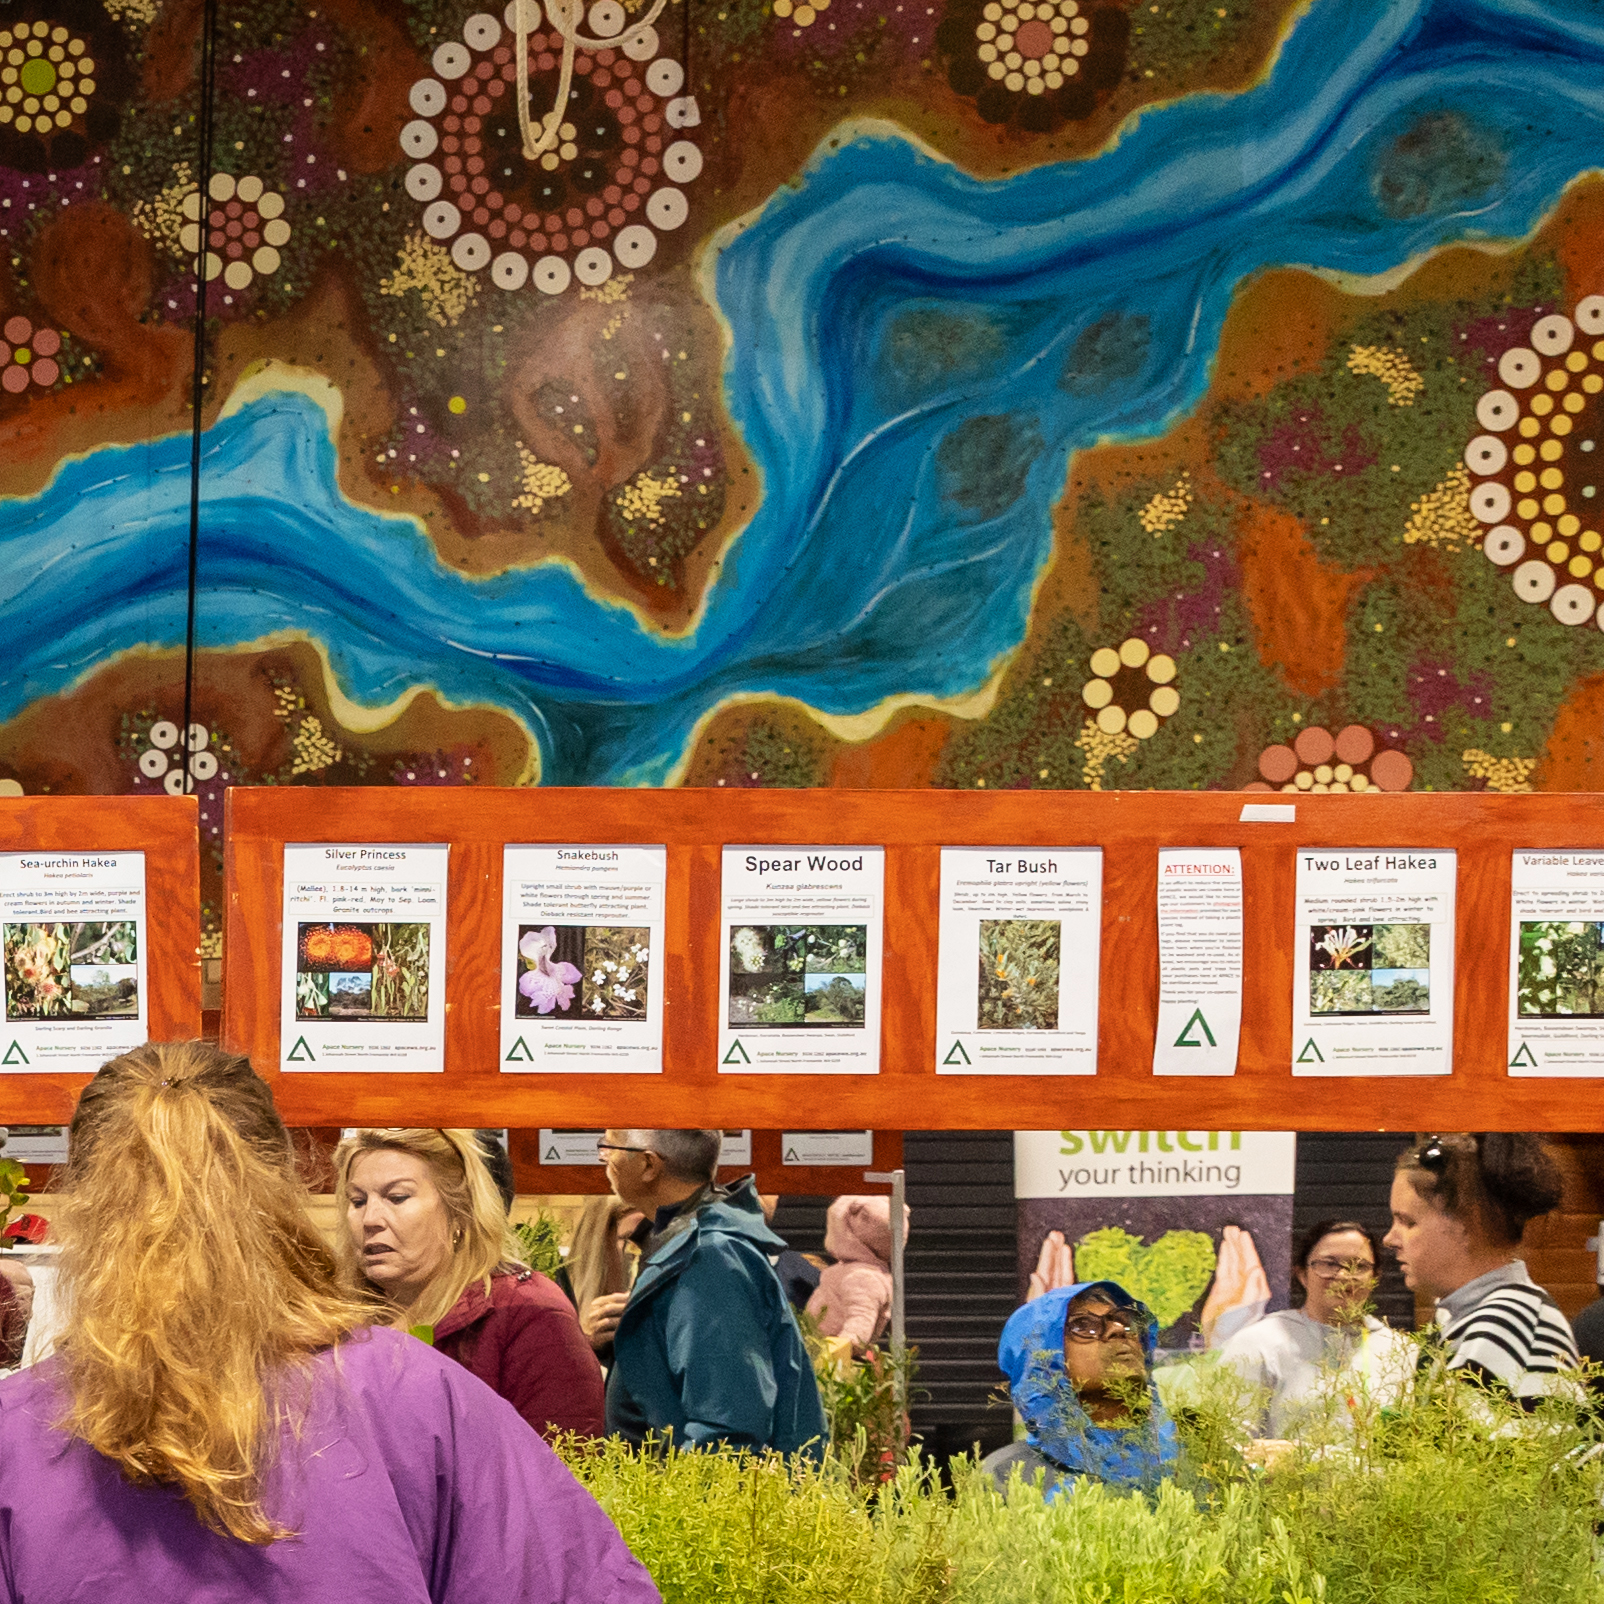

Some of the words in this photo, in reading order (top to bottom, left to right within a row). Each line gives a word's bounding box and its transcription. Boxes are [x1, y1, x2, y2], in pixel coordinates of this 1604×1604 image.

[324, 849, 357, 860] Silver
[360, 849, 407, 860] Princess
[557, 849, 619, 861] Snakebush
[20, 858, 79, 869] Sea-urchin
[82, 858, 117, 868] Hakea
[745, 856, 802, 875] Spear
[807, 856, 863, 872] Wood
[986, 859, 1013, 874] Tar
[1017, 859, 1058, 874] Bush
[1304, 857, 1340, 871] Two
[1345, 855, 1380, 871] Leaf
[1385, 855, 1437, 870] Hakea
[1522, 856, 1570, 866] Variable
[1164, 864, 1235, 875] ATTENTION:
[1058, 1167, 1122, 1191] your
[1128, 1159, 1242, 1189] thinking
